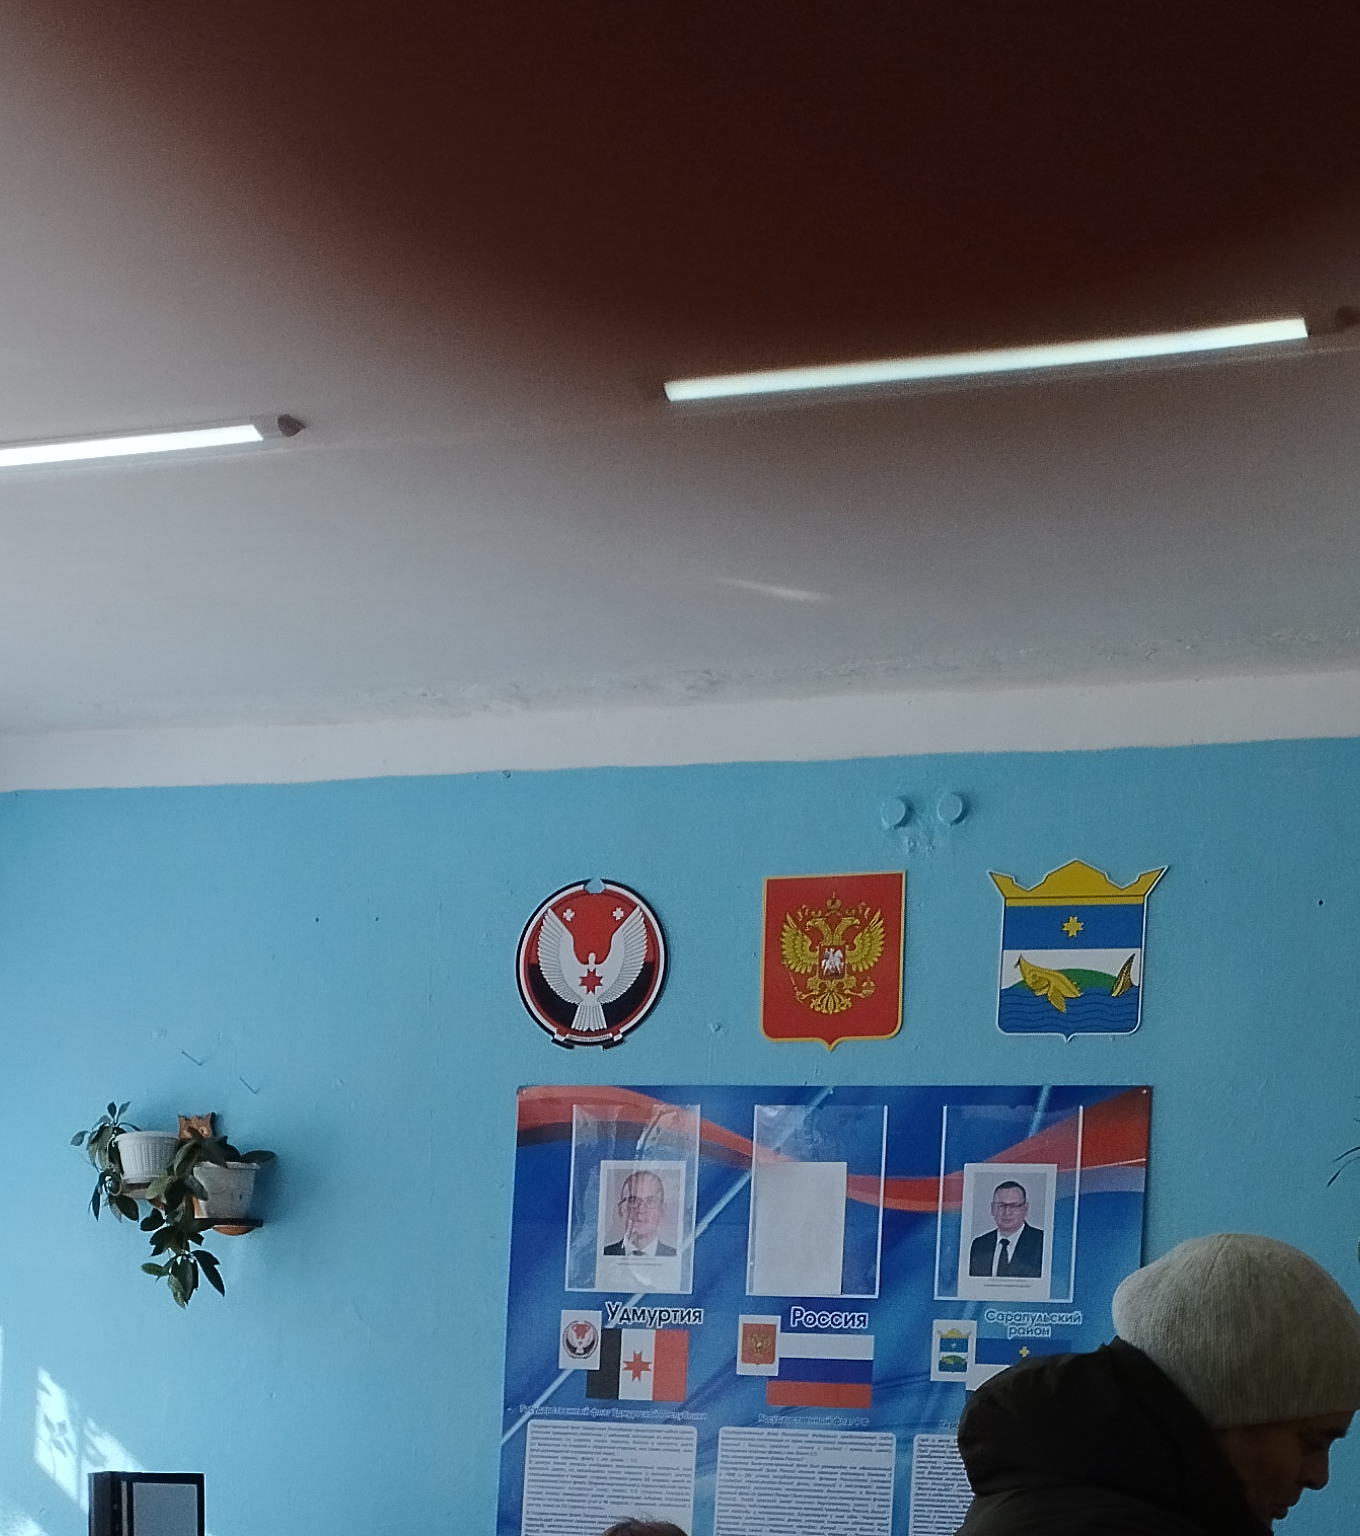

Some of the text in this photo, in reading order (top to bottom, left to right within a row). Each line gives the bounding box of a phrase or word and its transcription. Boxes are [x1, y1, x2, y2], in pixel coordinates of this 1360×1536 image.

[605, 1301, 704, 1327] Удмуртия
[790, 1306, 868, 1329] Россия
[985, 1309, 1082, 1326] Сарапульский
[1007, 1326, 1051, 1339] район
